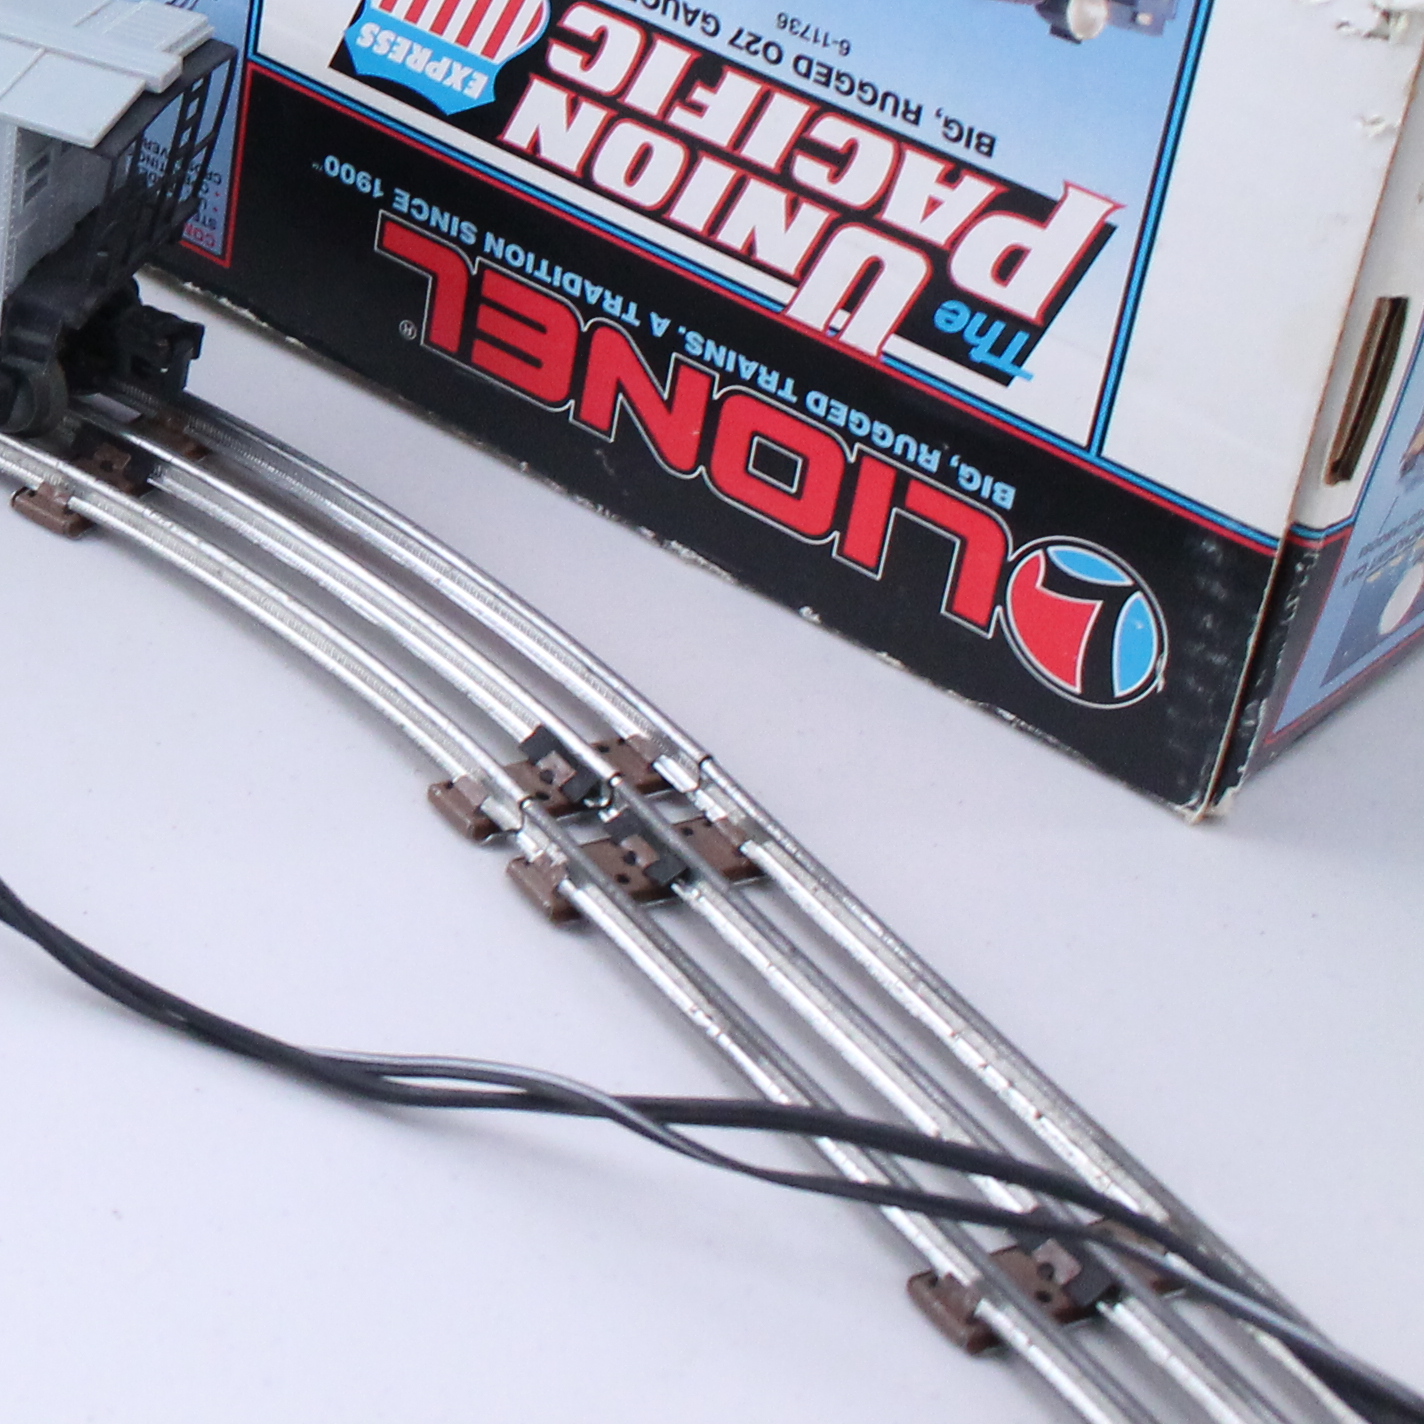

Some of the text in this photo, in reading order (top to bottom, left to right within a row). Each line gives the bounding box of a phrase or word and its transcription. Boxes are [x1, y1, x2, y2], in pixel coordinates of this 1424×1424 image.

[355, 21, 490, 100] EXPRESS
[775, 12, 852, 57] 6-11736
[792, 53, 924, 128] RUGGED
[545, 0, 1124, 326] PACIFIC
[935, 107, 997, 159] BIG,
[392, 187, 478, 245] SINCE
[496, 73, 933, 359] UNION
[483, 231, 642, 327] TRADITION
[649, 312, 672, 336] A
[932, 299, 1035, 382] The
[677, 326, 798, 403] TRAINS.
[372, 209, 1014, 639] LIONEL
[805, 389, 942, 474] RUGGED
[950, 454, 1018, 510] BIG,
